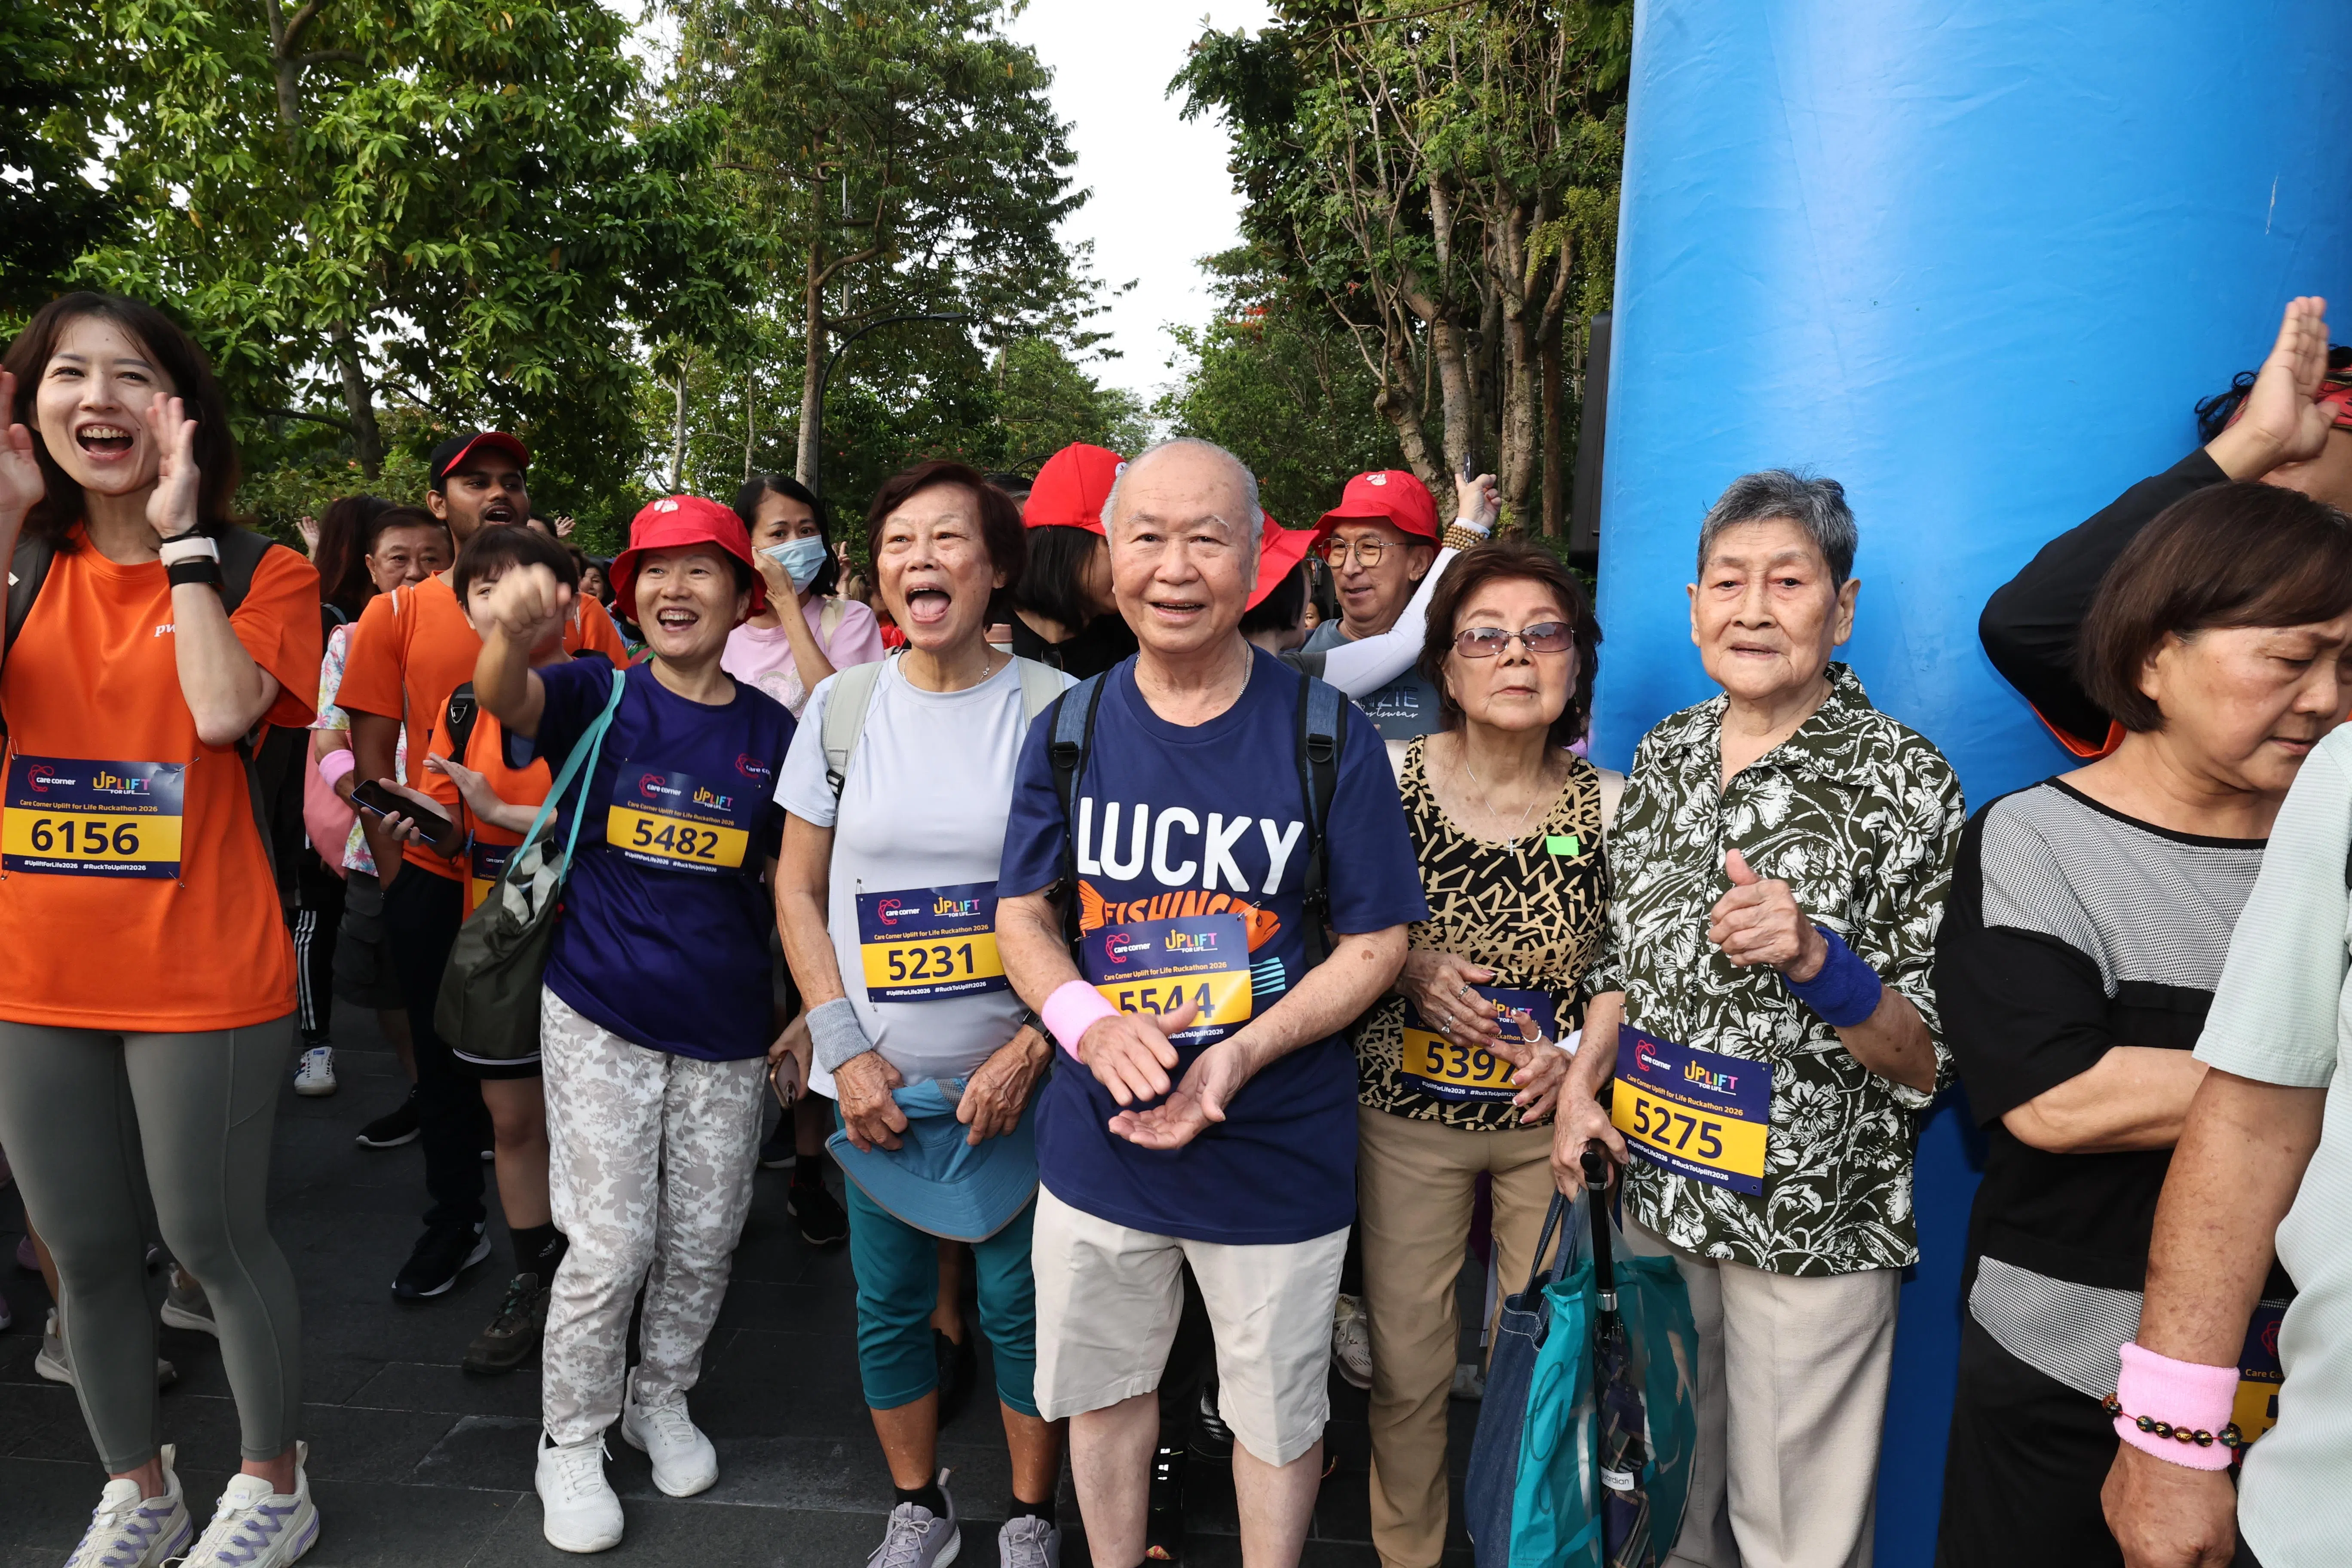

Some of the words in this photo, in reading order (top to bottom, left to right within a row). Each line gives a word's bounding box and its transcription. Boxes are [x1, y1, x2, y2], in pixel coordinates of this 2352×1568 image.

[93, 771, 152, 790] UPLIFT
[661, 787, 682, 796] corner
[693, 786, 733, 807] UPLIFT
[640, 802, 658, 812] Corner
[658, 806, 674, 815] Uplift
[693, 814, 720, 824] Ruckathon
[721, 818, 735, 826] 2026
[31, 819, 139, 855] 6156
[633, 818, 718, 859] 5482
[1078, 797, 1304, 895] LUCKY
[24, 860, 78, 869] #UpliftForLife2026
[625, 851, 669, 865] #UpliftForLife2026
[673, 861, 717, 873] #RuckToUplift2026
[934, 897, 980, 915] UPLIFT
[903, 931, 918, 940] Uplift
[941, 927, 972, 935] Ruckathon
[1165, 929, 1217, 949] UPLIFT
[1128, 943, 1151, 951] corner
[888, 943, 974, 981] 5231
[1133, 970, 1149, 979] Uplift
[1173, 964, 1208, 973] Ruckathon
[886, 988, 931, 997] #UpliftForLife2026
[935, 982, 986, 992] #RuckToUplift2026
[1119, 983, 1215, 1018] 5544
[1642, 1054, 1652, 1064] care
[1652, 1058, 1671, 1070] corner
[1684, 1060, 1738, 1090] UPLIFT
[1422, 1081, 1466, 1094] #UpliftForLife2026
[1627, 1074, 1636, 1083] Care
[1637, 1078, 1651, 1090] Corner
[1652, 1083, 1666, 1096] Uplift
[1675, 1093, 1687, 1102] Life
[1688, 1097, 1723, 1111] Ruckathon
[1724, 1106, 1743, 1116] 2026
[1634, 1097, 1722, 1159] 5275
[1628, 1139, 1668, 1162] #UpliftForLife2026
[1672, 1159, 1729, 1181] #RuckToUplift2026
[2245, 1369, 2267, 1377] Care
